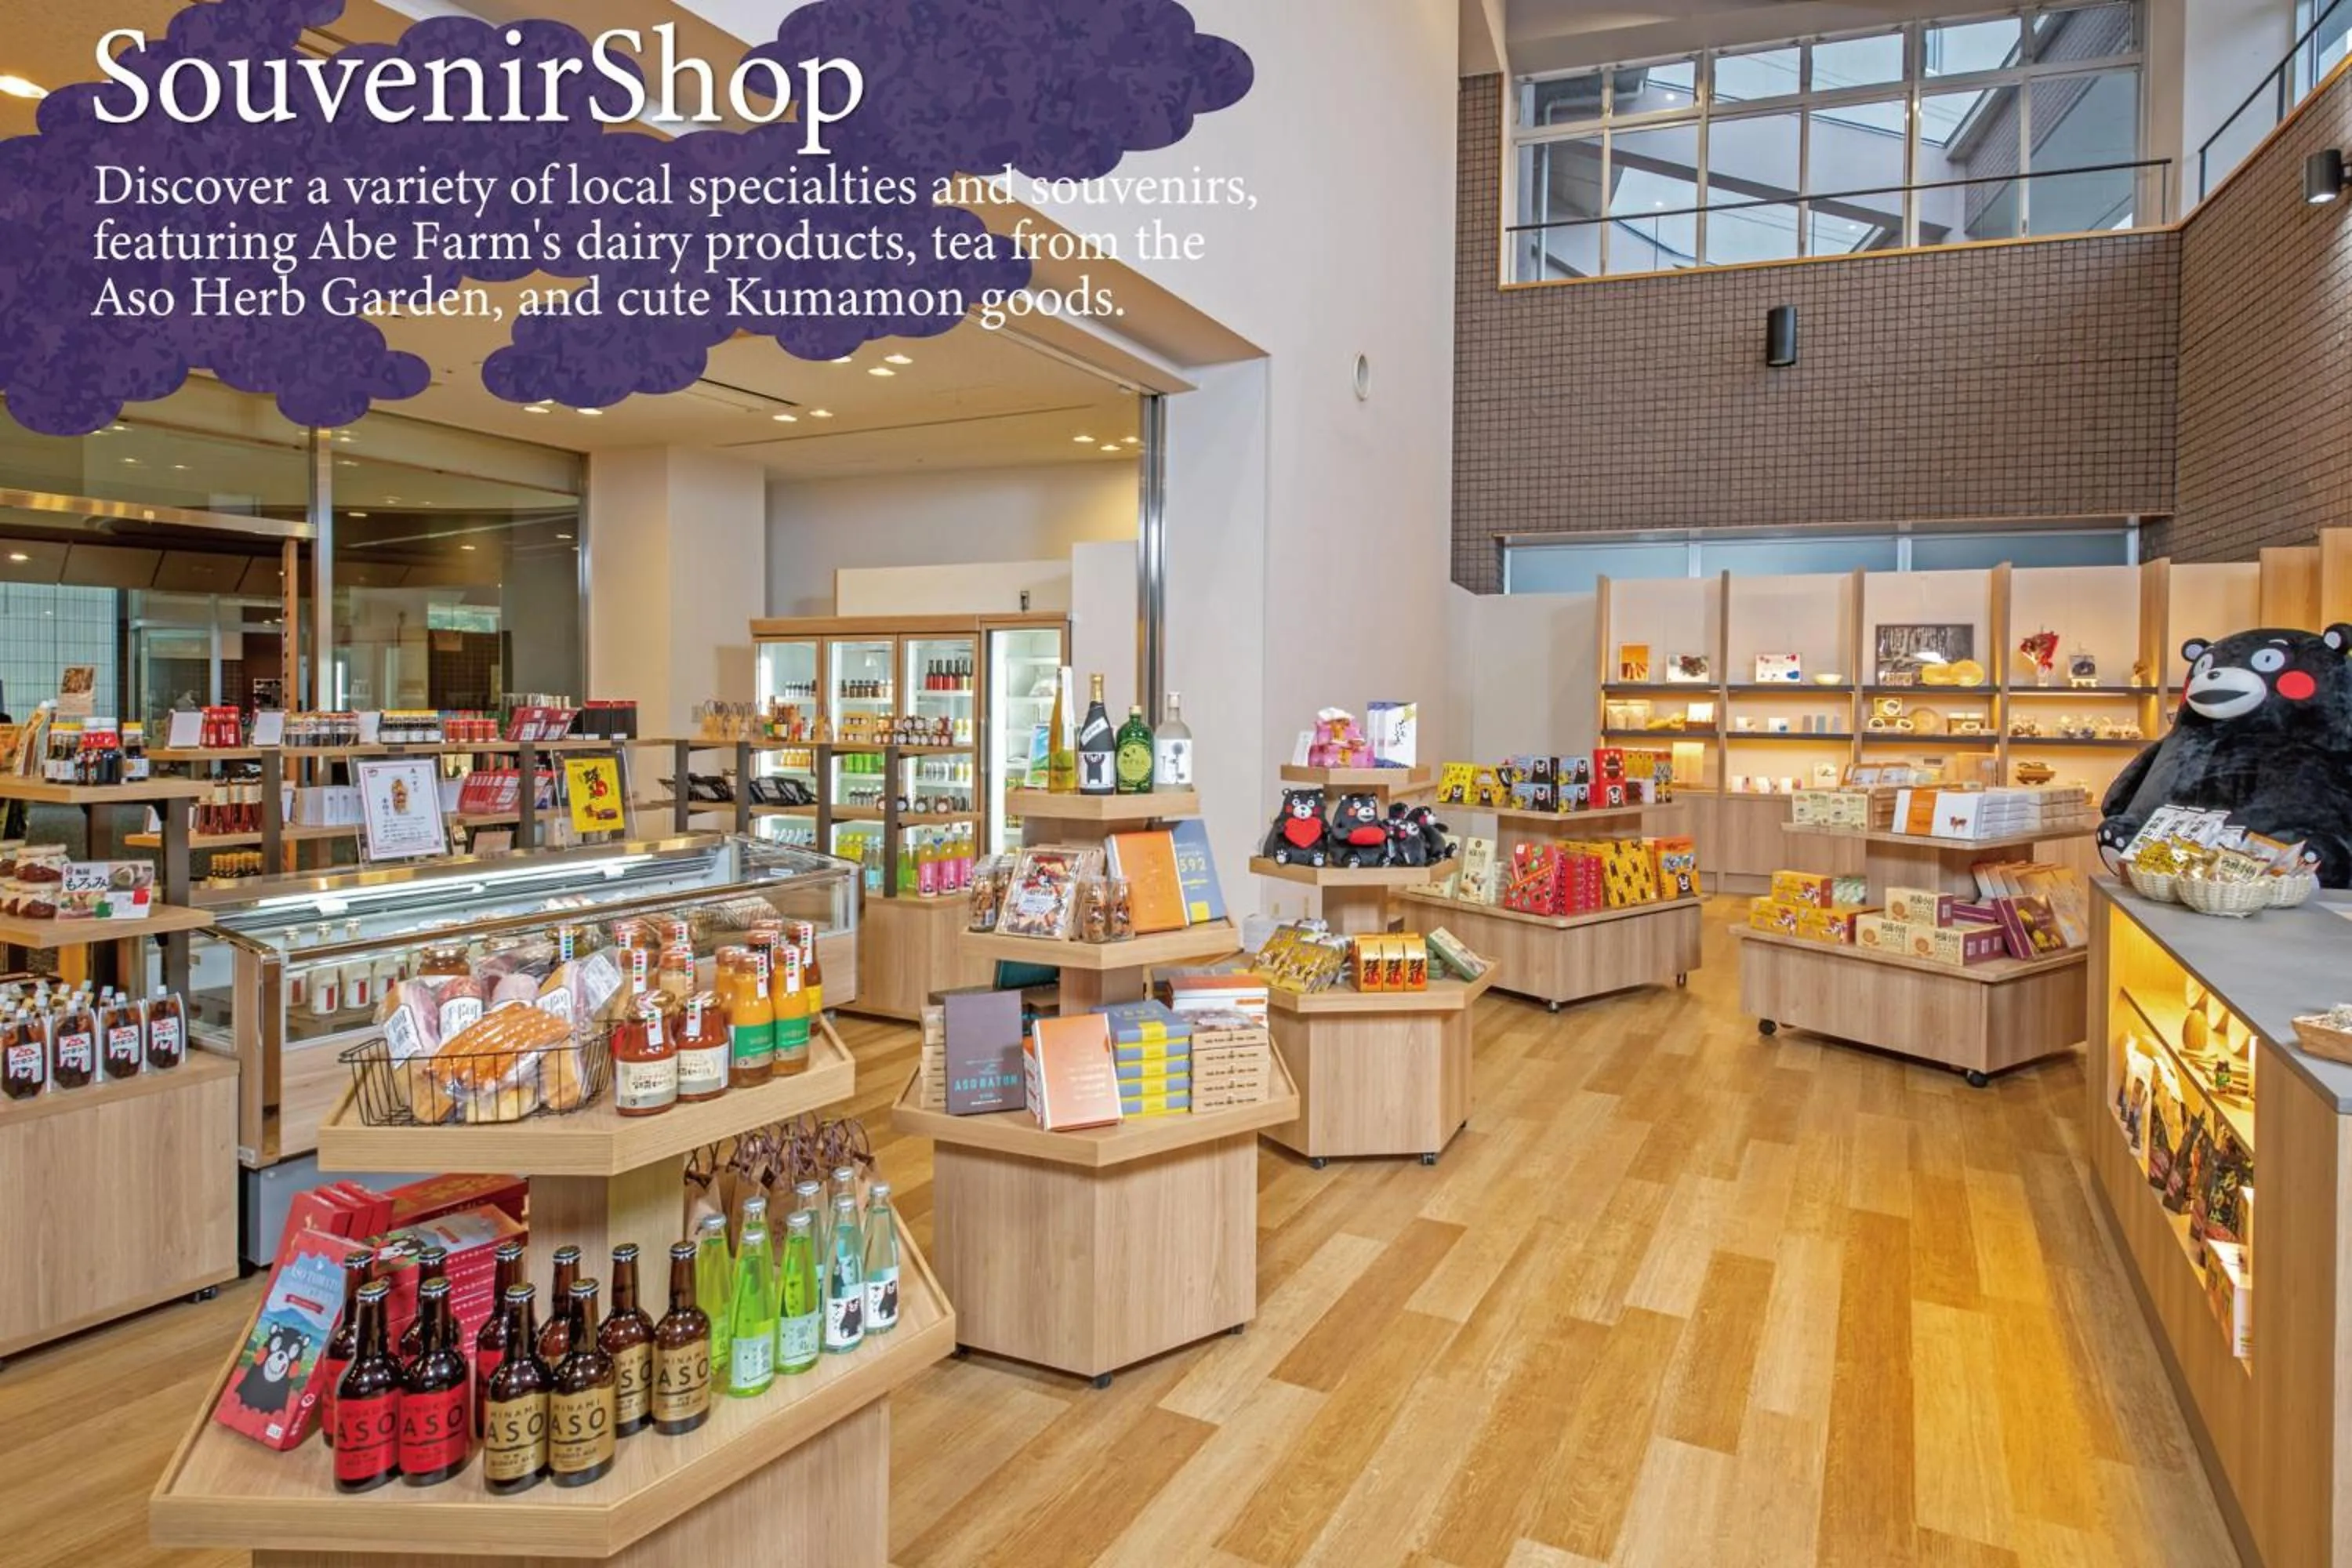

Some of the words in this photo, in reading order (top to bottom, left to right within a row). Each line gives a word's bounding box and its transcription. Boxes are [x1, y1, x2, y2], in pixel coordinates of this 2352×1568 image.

[1178, 857, 1207, 873] 592
[620, 1359, 652, 1389] SO
[658, 1357, 709, 1388] ASO
[338, 1412, 396, 1443] ASO
[404, 1405, 463, 1437] ASO
[488, 1412, 544, 1443] ASO
[551, 1407, 607, 1436] ASO
